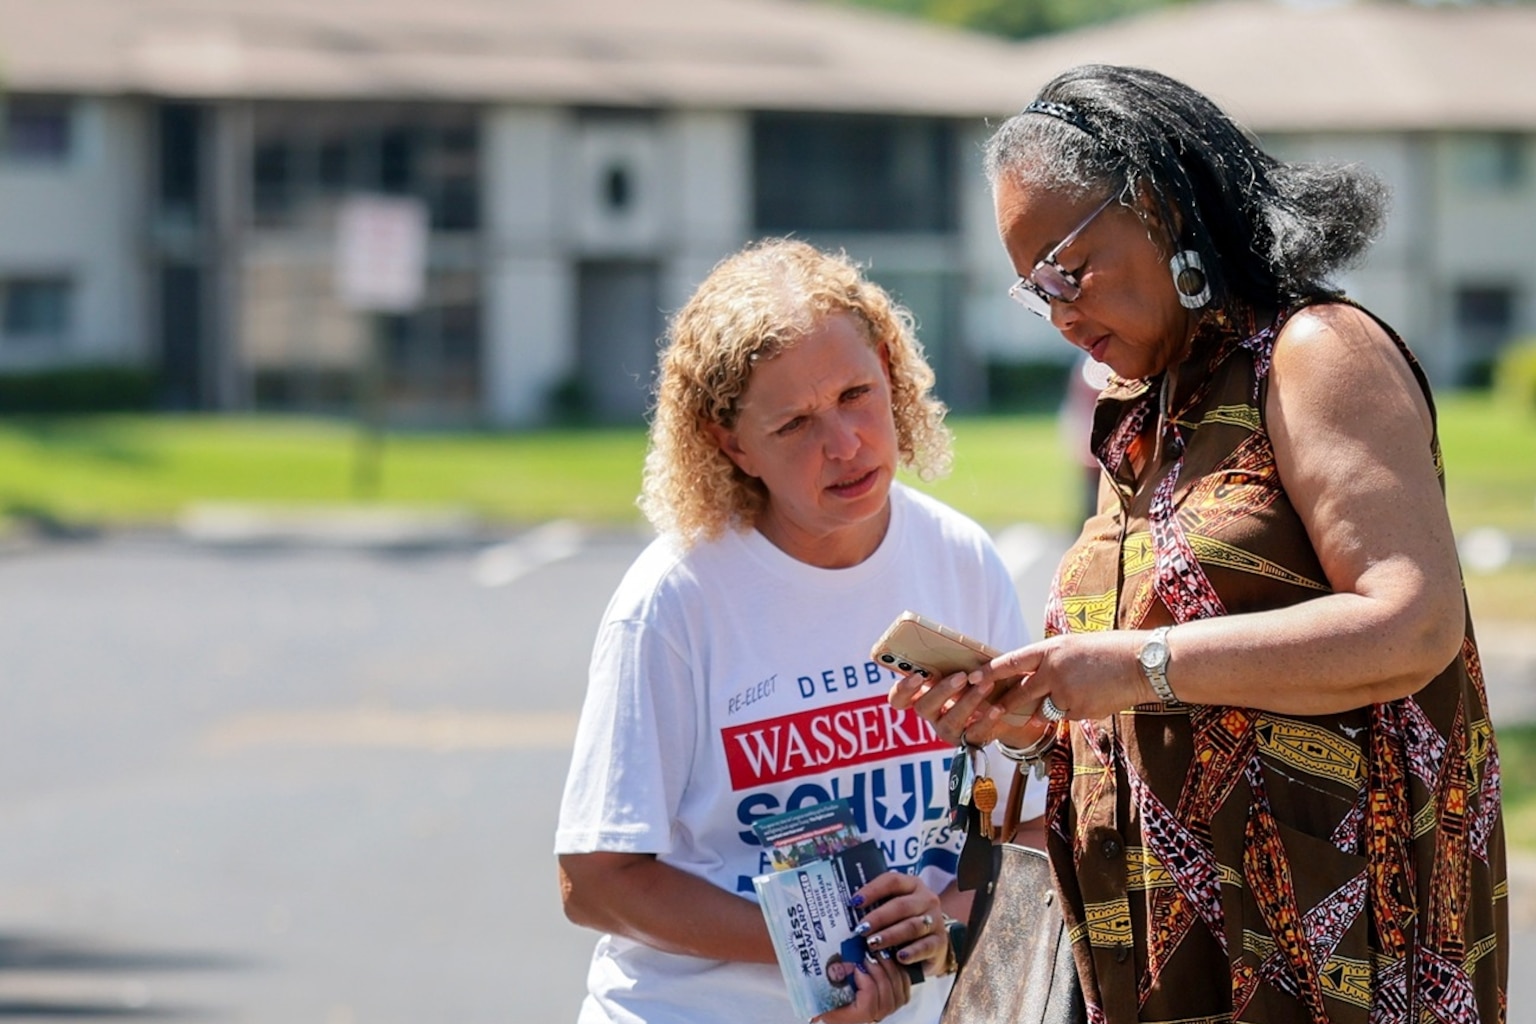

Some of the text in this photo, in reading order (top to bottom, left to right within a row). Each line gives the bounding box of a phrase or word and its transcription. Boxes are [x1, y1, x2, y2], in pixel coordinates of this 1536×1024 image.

[728, 674, 778, 715] RE-ELECT
[798, 661, 896, 699] DEBB
[735, 704, 942, 778] WASSER
[799, 873, 819, 922] ENDORSED
[814, 890, 826, 917] DEBBIE
[816, 874, 836, 928] WASSERMAN
[825, 882, 840, 917] SCHULTZ
[787, 906, 810, 961] BLESS
[797, 904, 822, 976] BROWARD
